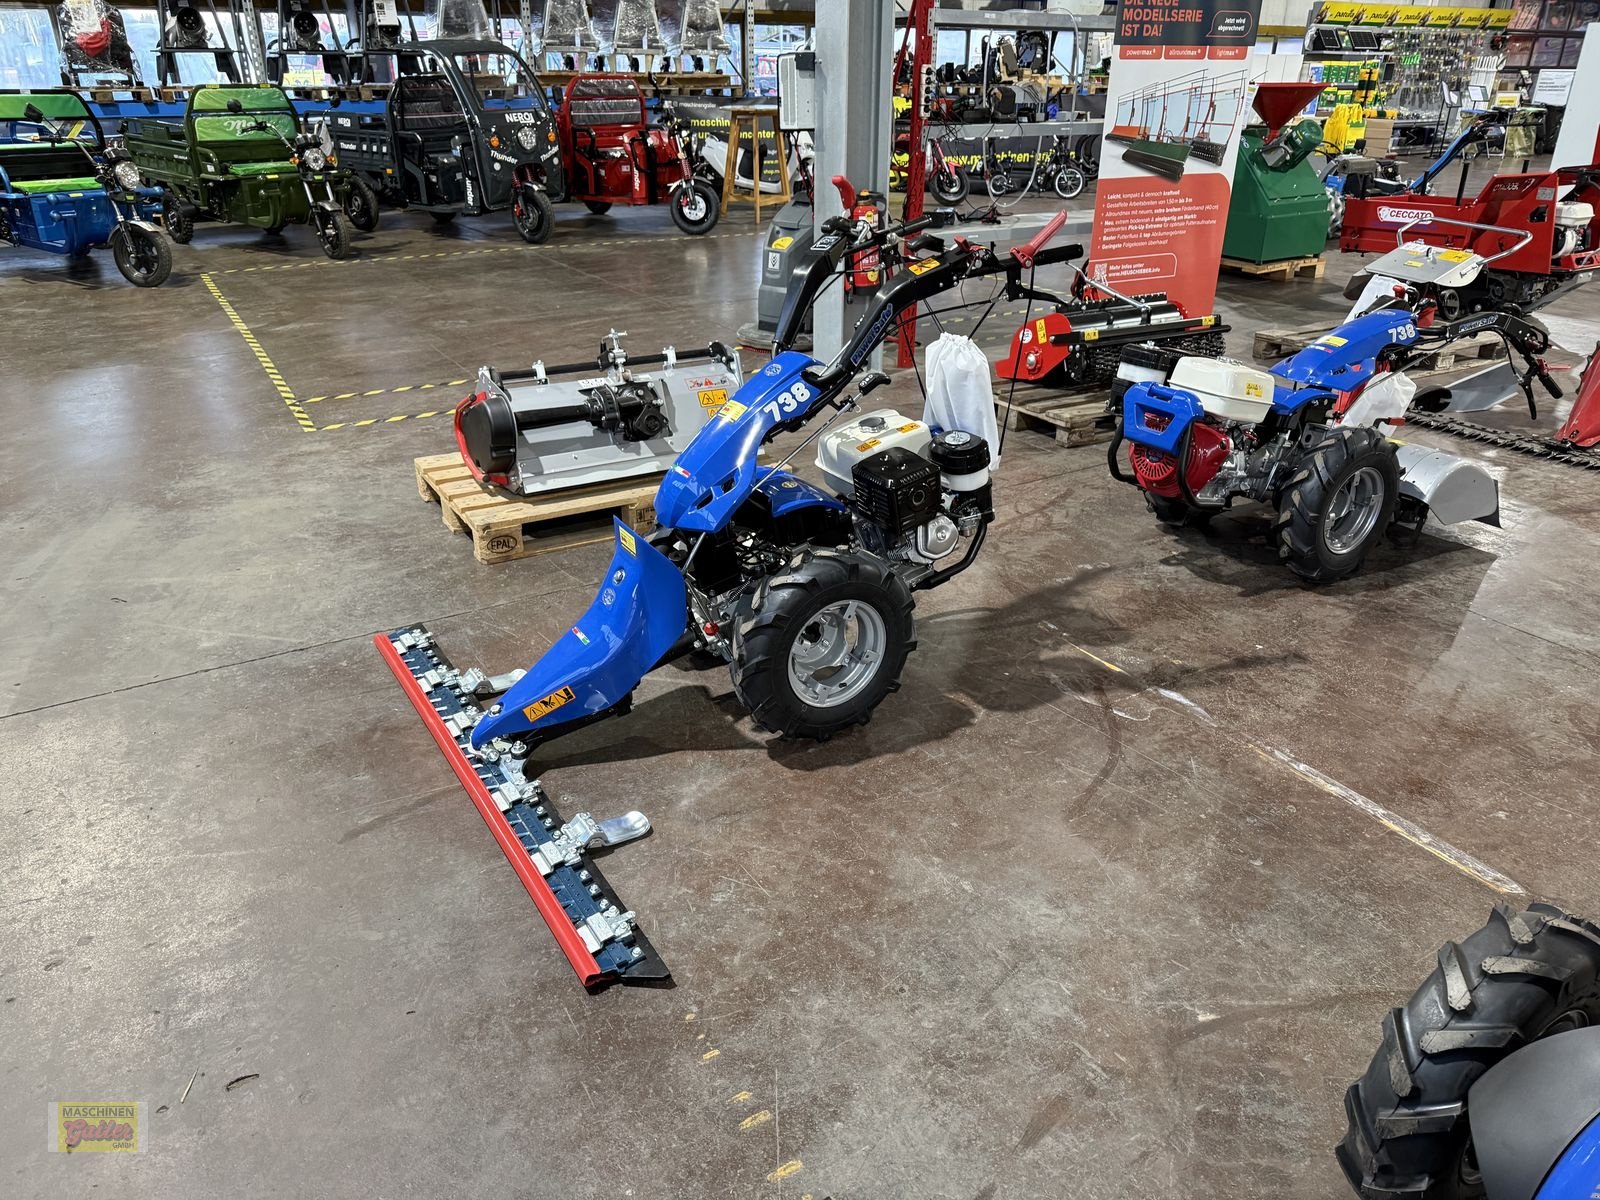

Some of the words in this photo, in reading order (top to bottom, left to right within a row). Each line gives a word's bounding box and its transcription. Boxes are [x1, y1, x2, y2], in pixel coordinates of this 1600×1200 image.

[1123, 8, 1203, 22] MODELLSERIE
[1121, 24, 1140, 37] IST
[1143, 24, 1163, 37] DA!
[490, 149, 518, 165] Thunder
[1390, 210, 1432, 219] CECCATO
[1388, 323, 1415, 343] 738
[763, 382, 811, 422] 738
[490, 538, 513, 550] EPAL
